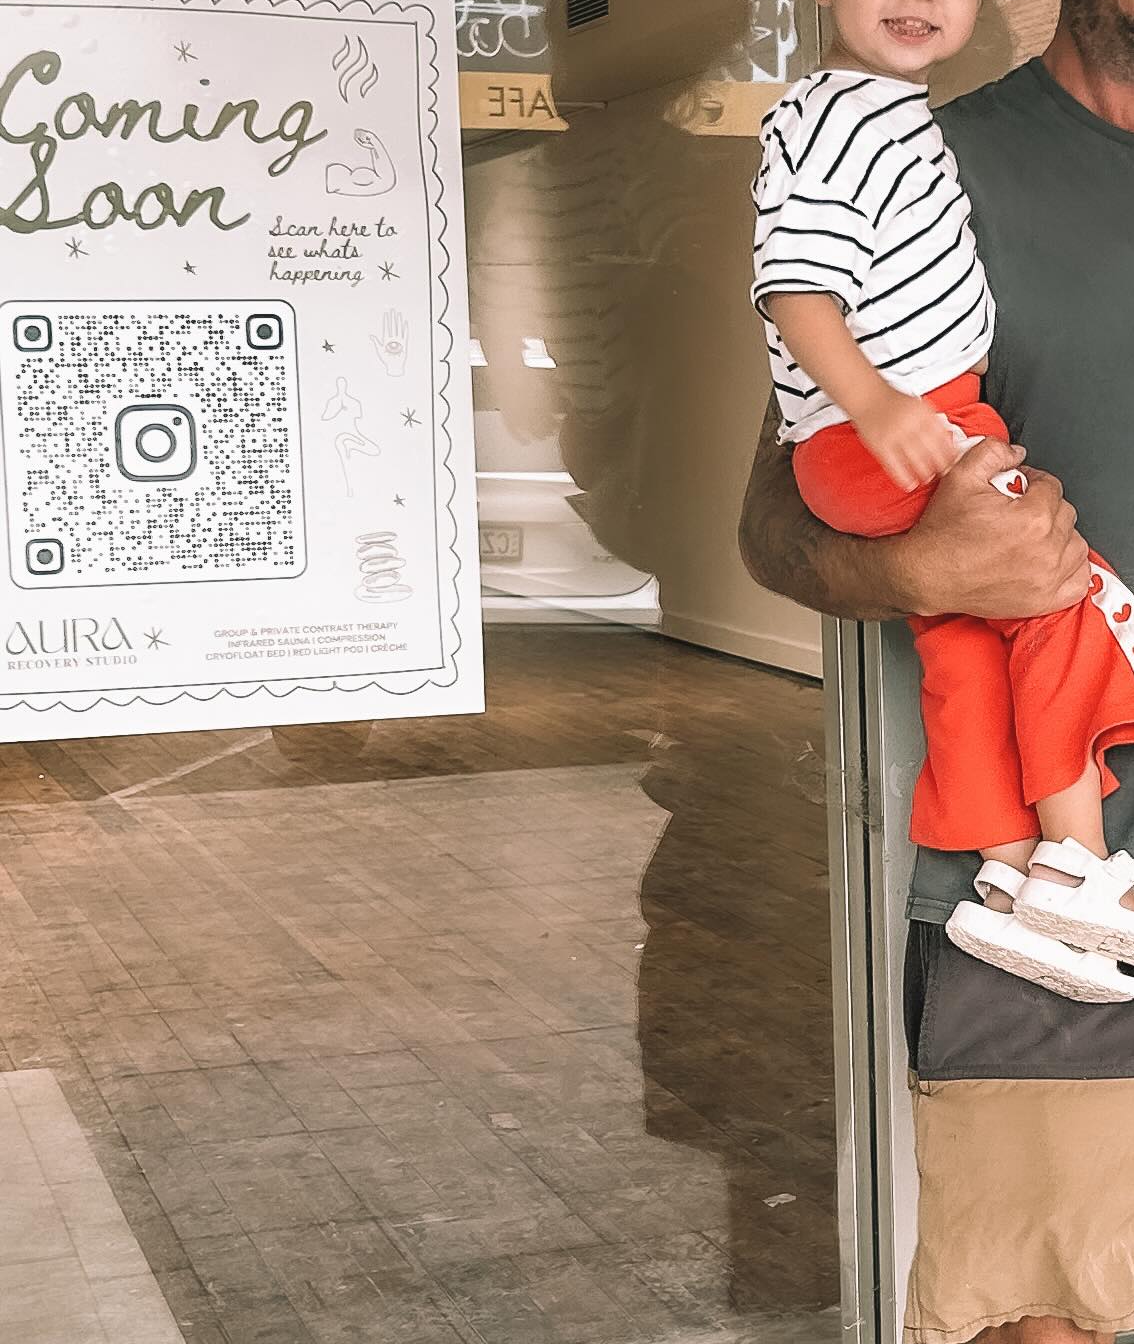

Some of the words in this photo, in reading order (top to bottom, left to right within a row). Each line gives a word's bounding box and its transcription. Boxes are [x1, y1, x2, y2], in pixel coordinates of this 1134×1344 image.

[0, 50, 328, 177] Coming
[0, 137, 251, 234] Soon
[269, 216, 323, 236] Scan
[328, 216, 371, 237] here
[375, 216, 398, 237] to
[268, 246, 297, 258] see
[303, 238, 363, 259] whats
[270, 260, 365, 287] happening
[6, 617, 133, 655] AURA
[214, 629, 248, 637] GROUP
[260, 626, 300, 635] PRIVATE
[302, 623, 353, 634] CONTRAST
[357, 622, 398, 631] THERAPY
[228, 639, 275, 648] INFRARED
[278, 637, 310, 646] SAUNA
[317, 634, 386, 644] COMPRESSION
[7, 658, 79, 670] RECOVERY
[86, 655, 138, 666] STUDIO
[206, 650, 264, 661] CRYOFLOAT
[267, 649, 285, 657] BED
[293, 648, 311, 656] RED
[313, 646, 341, 655] LIGHT
